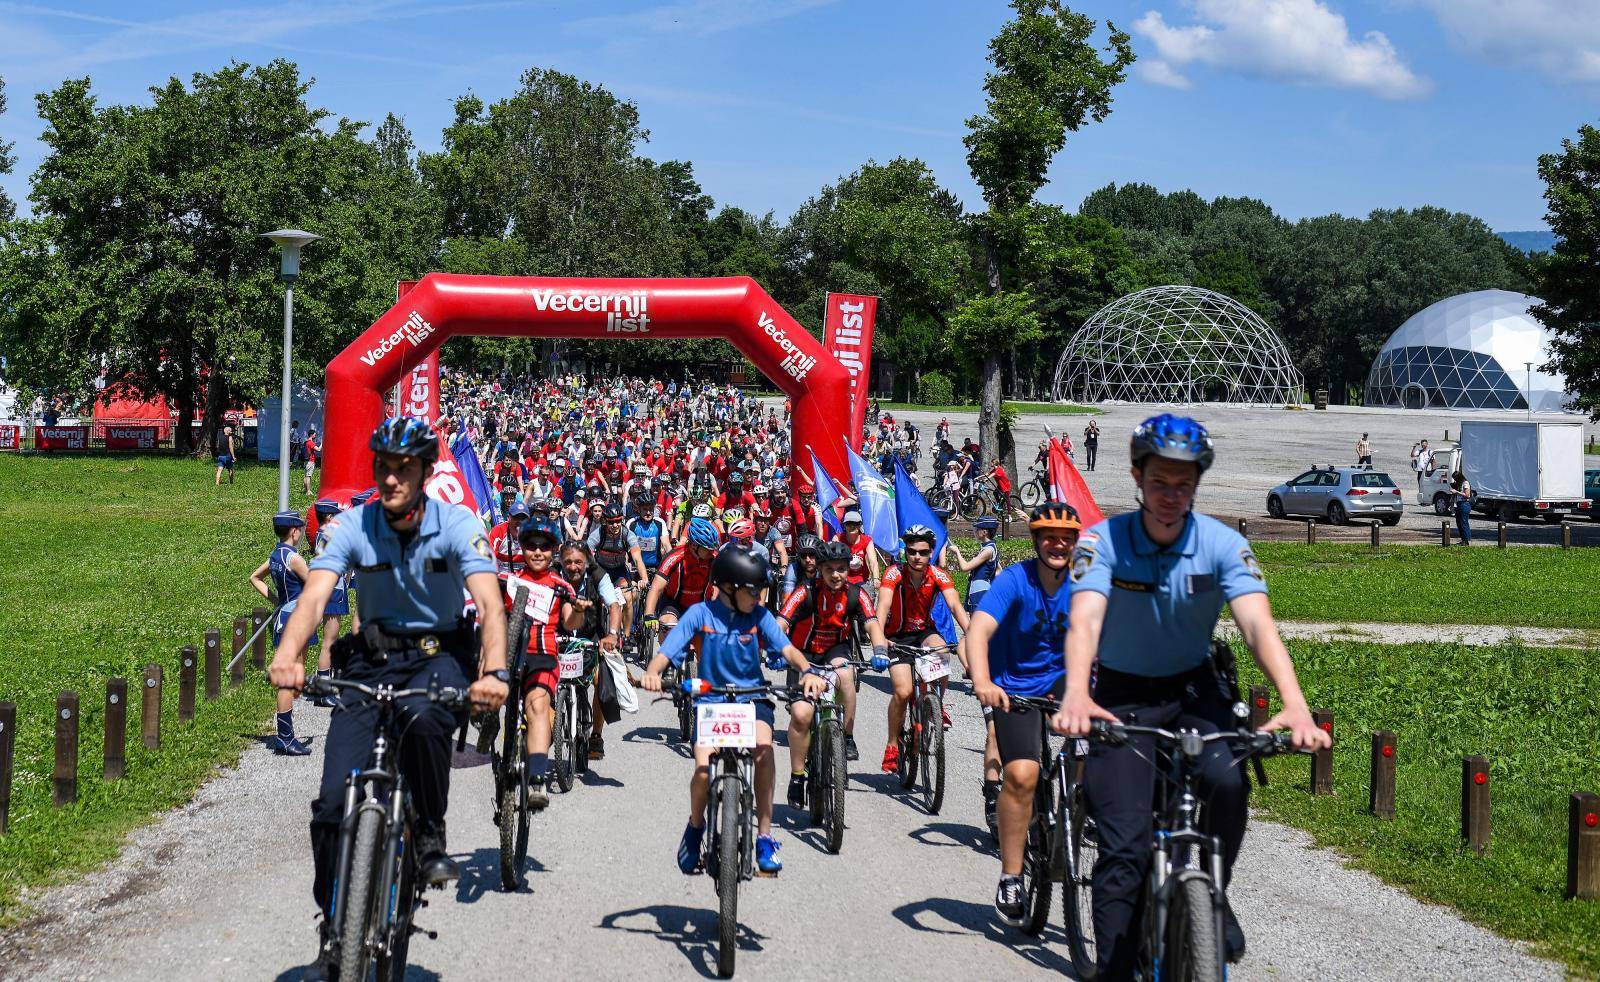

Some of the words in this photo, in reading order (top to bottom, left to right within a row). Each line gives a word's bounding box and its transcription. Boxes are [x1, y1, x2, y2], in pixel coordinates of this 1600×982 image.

[531, 289, 648, 318] Večernji
[607, 312, 651, 332] list
[836, 302, 864, 345] list
[360, 311, 424, 366] Večernji
[406, 321, 436, 347] list
[757, 311, 817, 373] Večernji
[780, 355, 807, 383] list
[41, 428, 85, 440] Večernji
[110, 428, 155, 439] Večernji
[137, 438, 155, 449] list
[67, 439, 85, 449] list
[561, 663, 578, 671] 700
[712, 722, 741, 735] 463
